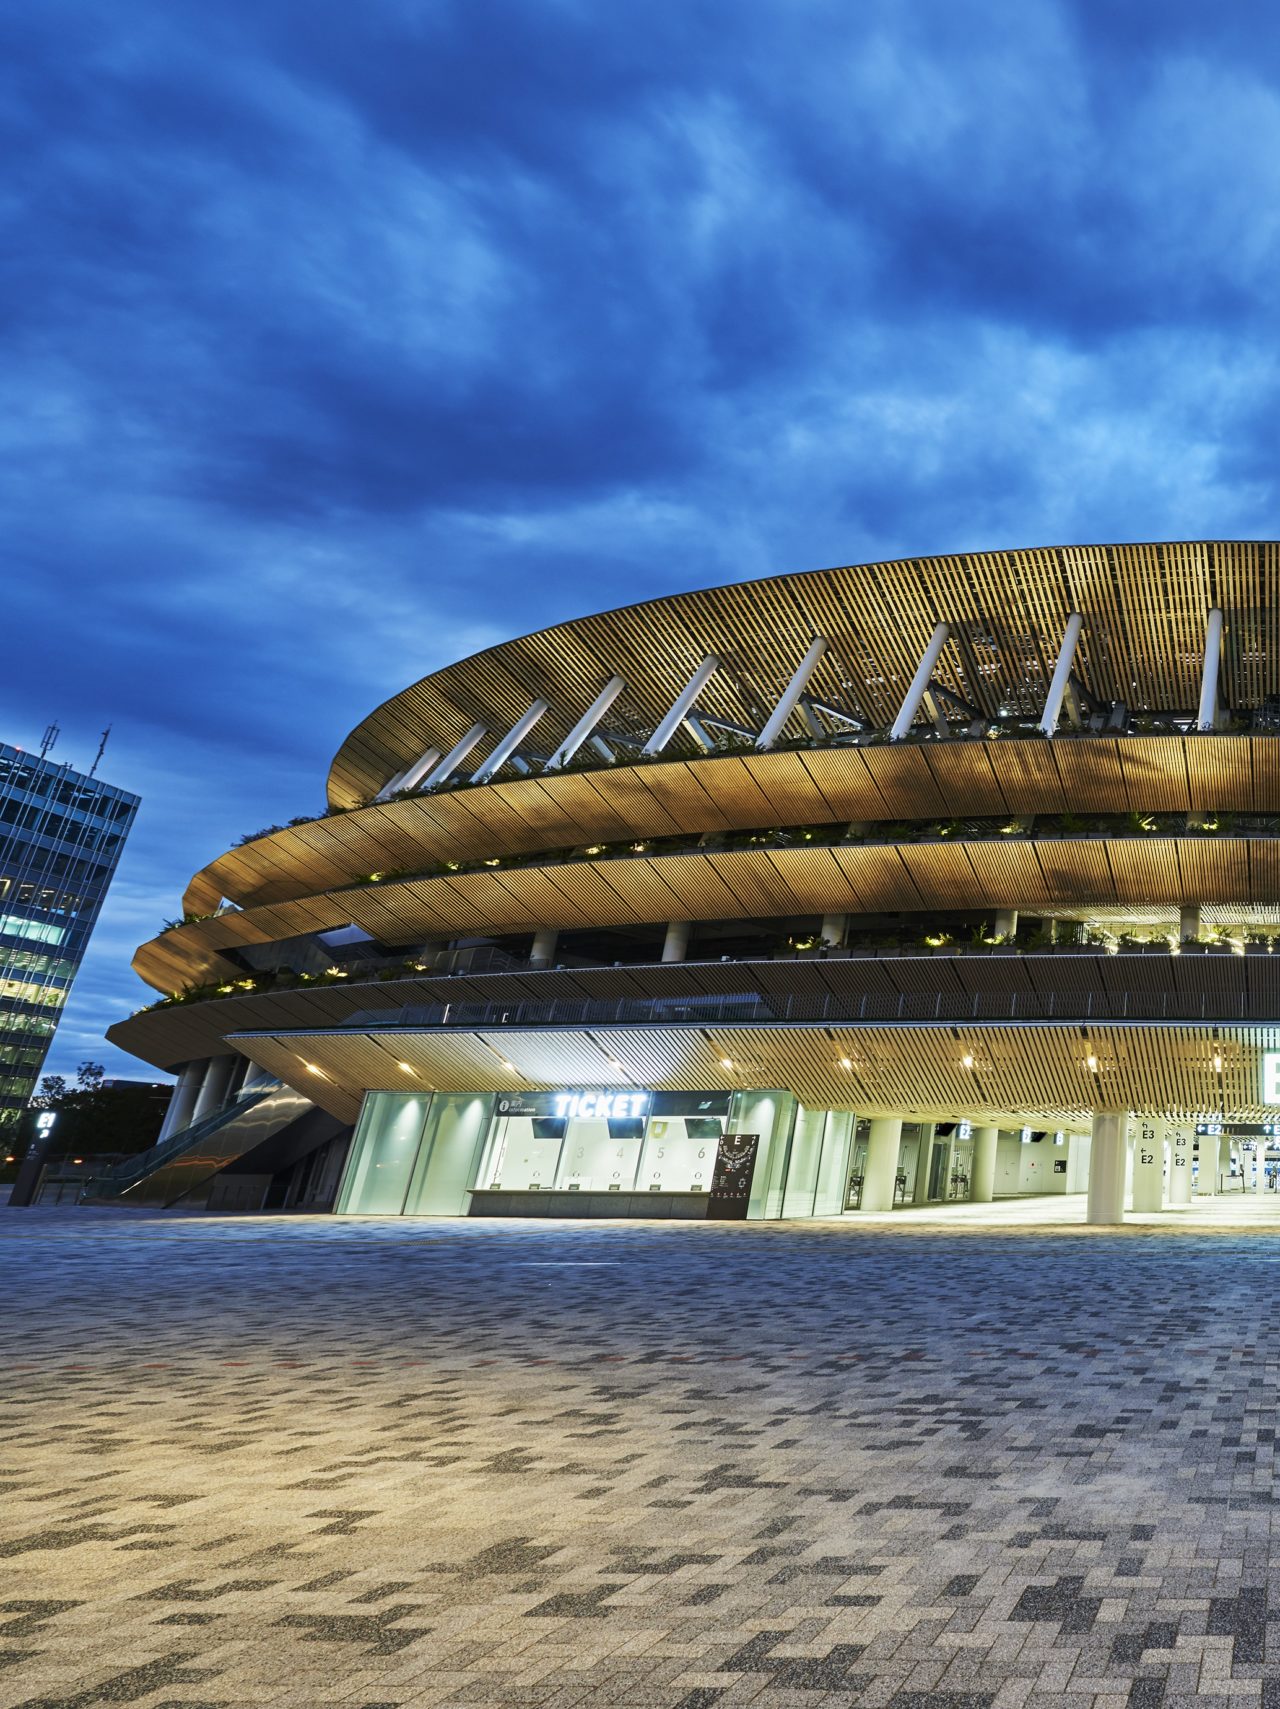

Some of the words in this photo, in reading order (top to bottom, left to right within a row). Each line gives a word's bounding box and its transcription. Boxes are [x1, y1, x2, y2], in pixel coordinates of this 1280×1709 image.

[554, 1094, 648, 1117] TICKET
[37, 1112, 56, 1128] E1
[1142, 1130, 1155, 1139] E3
[1207, 1124, 1222, 1135] E2
[734, 1135, 741, 1145] E
[1176, 1138, 1186, 1146] E3
[576, 1147, 585, 1159] 3
[616, 1147, 625, 1159] 4
[657, 1147, 665, 1159] 5
[697, 1147, 706, 1159] 6
[1141, 1154, 1153, 1164] E2
[1175, 1158, 1185, 1166] E2
